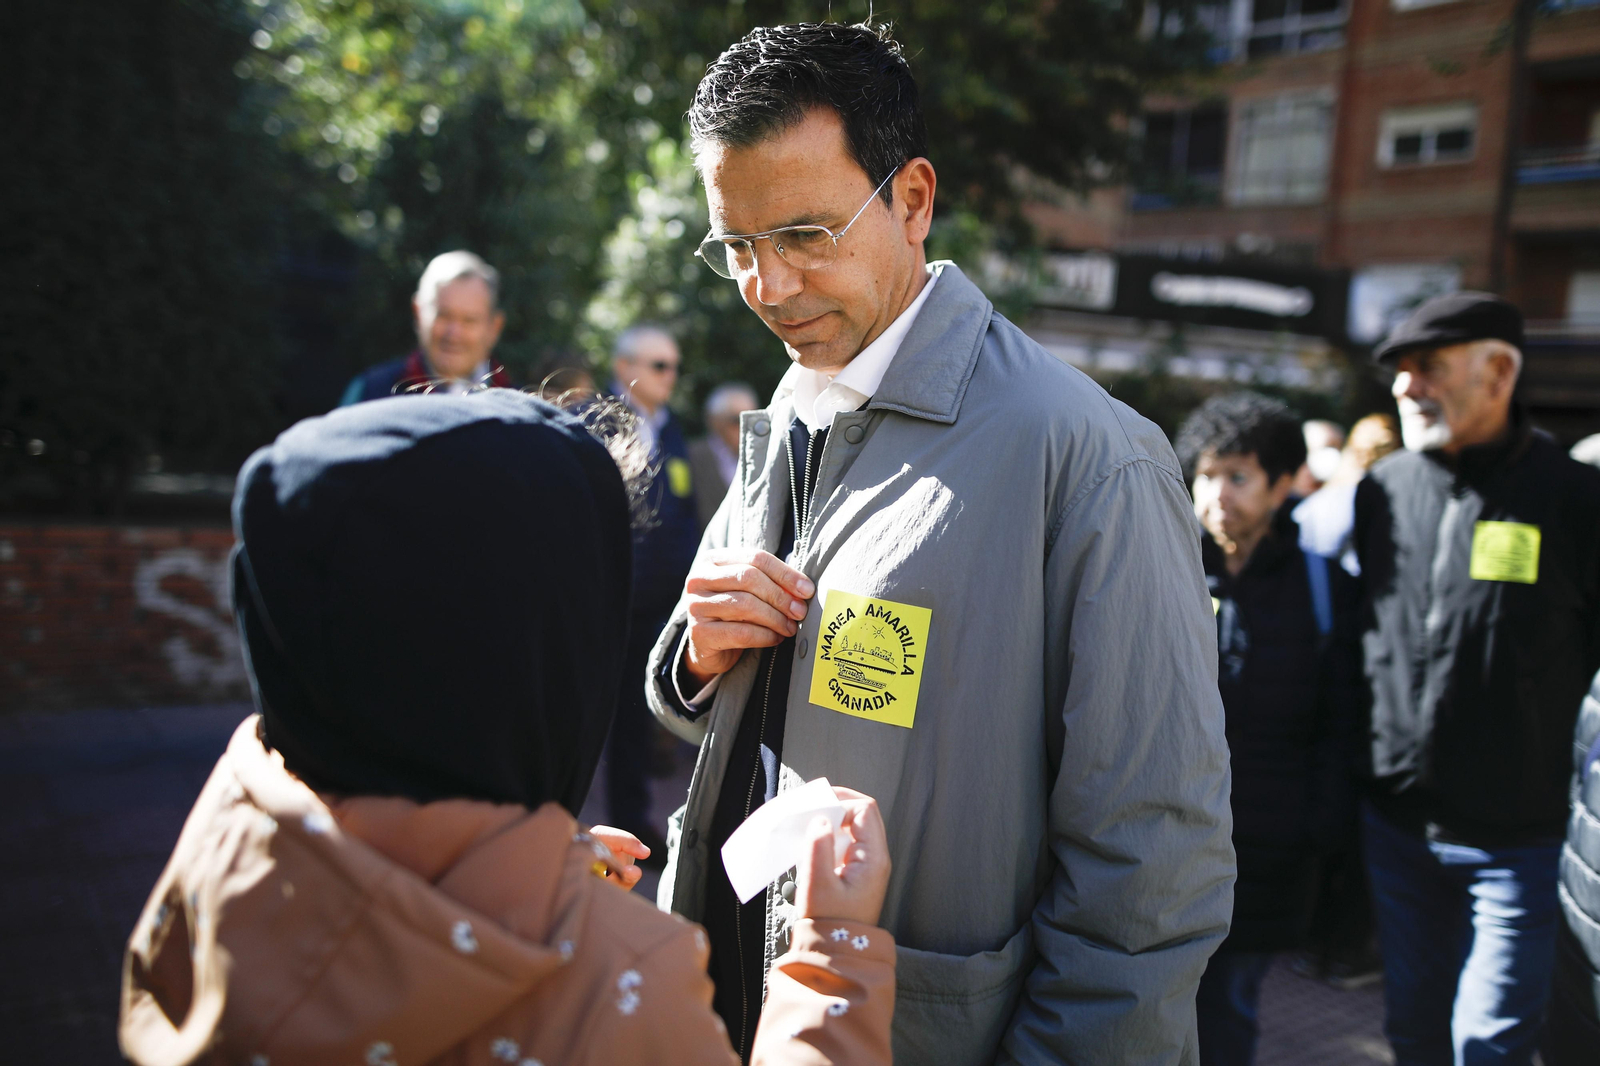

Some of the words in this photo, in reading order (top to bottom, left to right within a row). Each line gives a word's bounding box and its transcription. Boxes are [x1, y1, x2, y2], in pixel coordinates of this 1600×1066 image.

[820, 607, 856, 661] MAREA
[865, 603, 917, 676] AMARILLA
[828, 678, 897, 711] GRANADA
